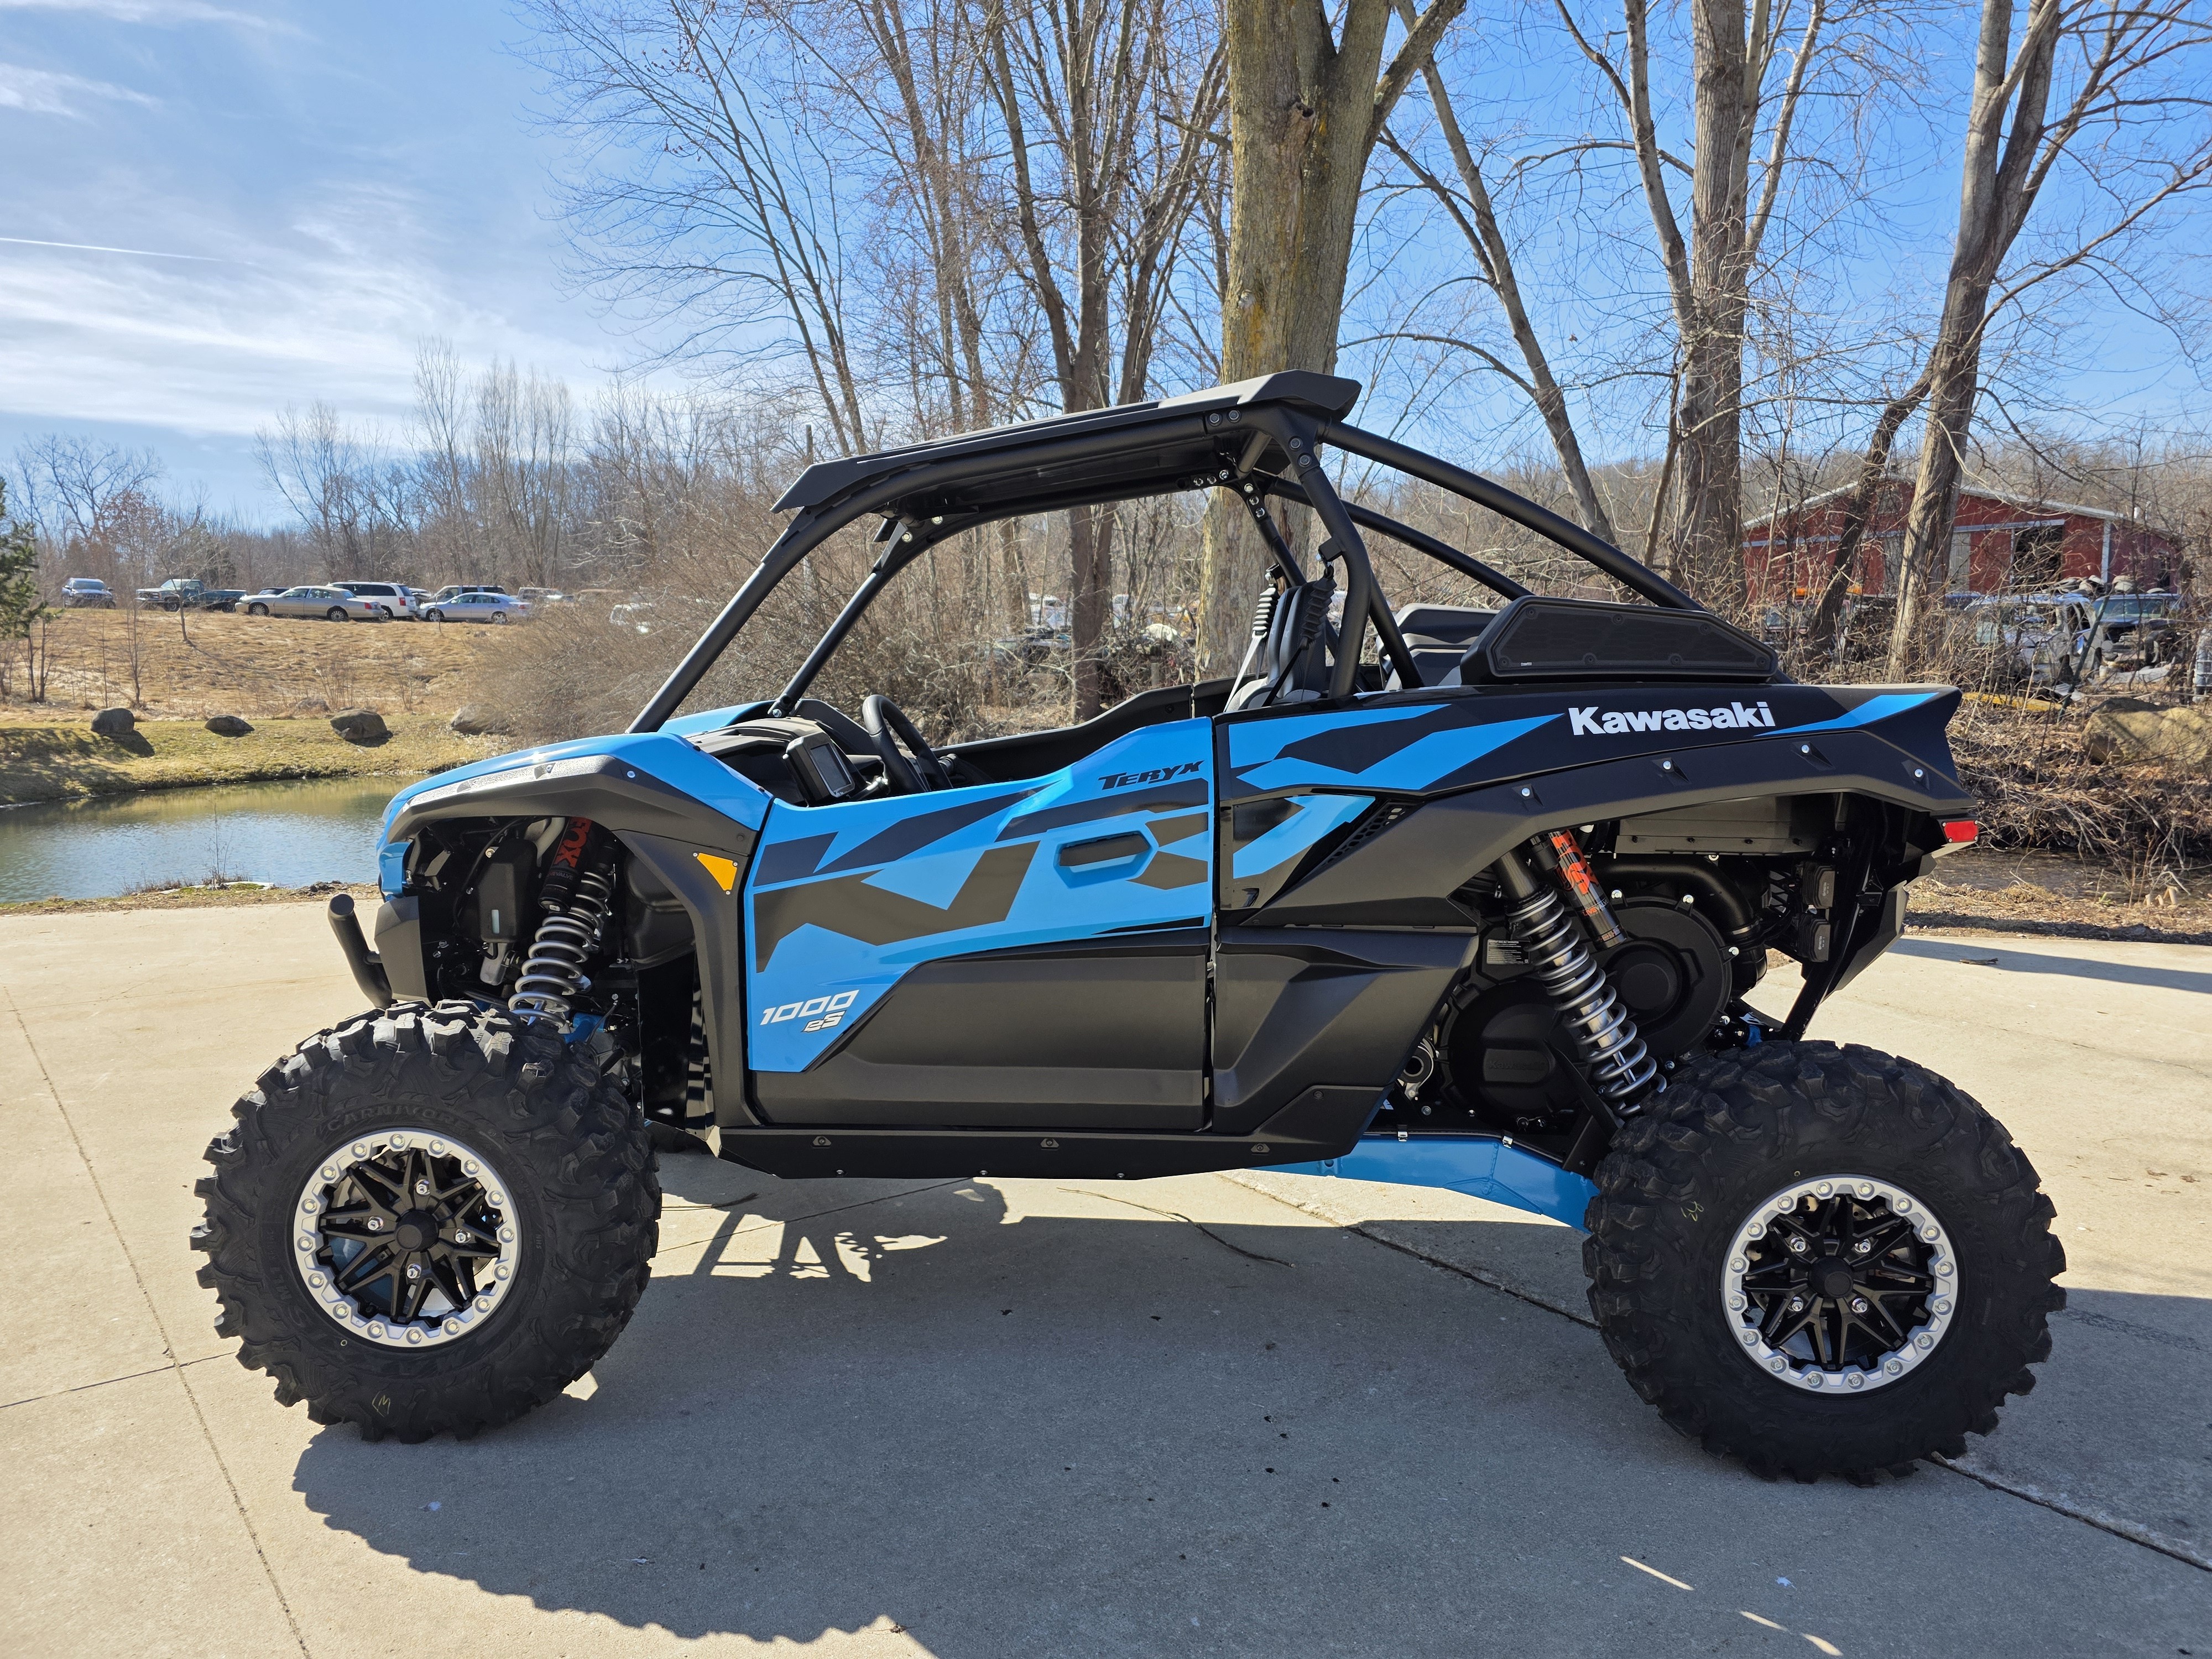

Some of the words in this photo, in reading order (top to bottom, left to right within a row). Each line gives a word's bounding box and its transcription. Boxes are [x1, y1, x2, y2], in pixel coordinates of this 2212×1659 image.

[1568, 701, 1776, 735] Kawasaki
[1098, 760, 1204, 790] TERYX
[554, 816, 593, 868] FOX
[1551, 830, 1600, 895] FOX
[760, 989, 859, 1025] 1000
